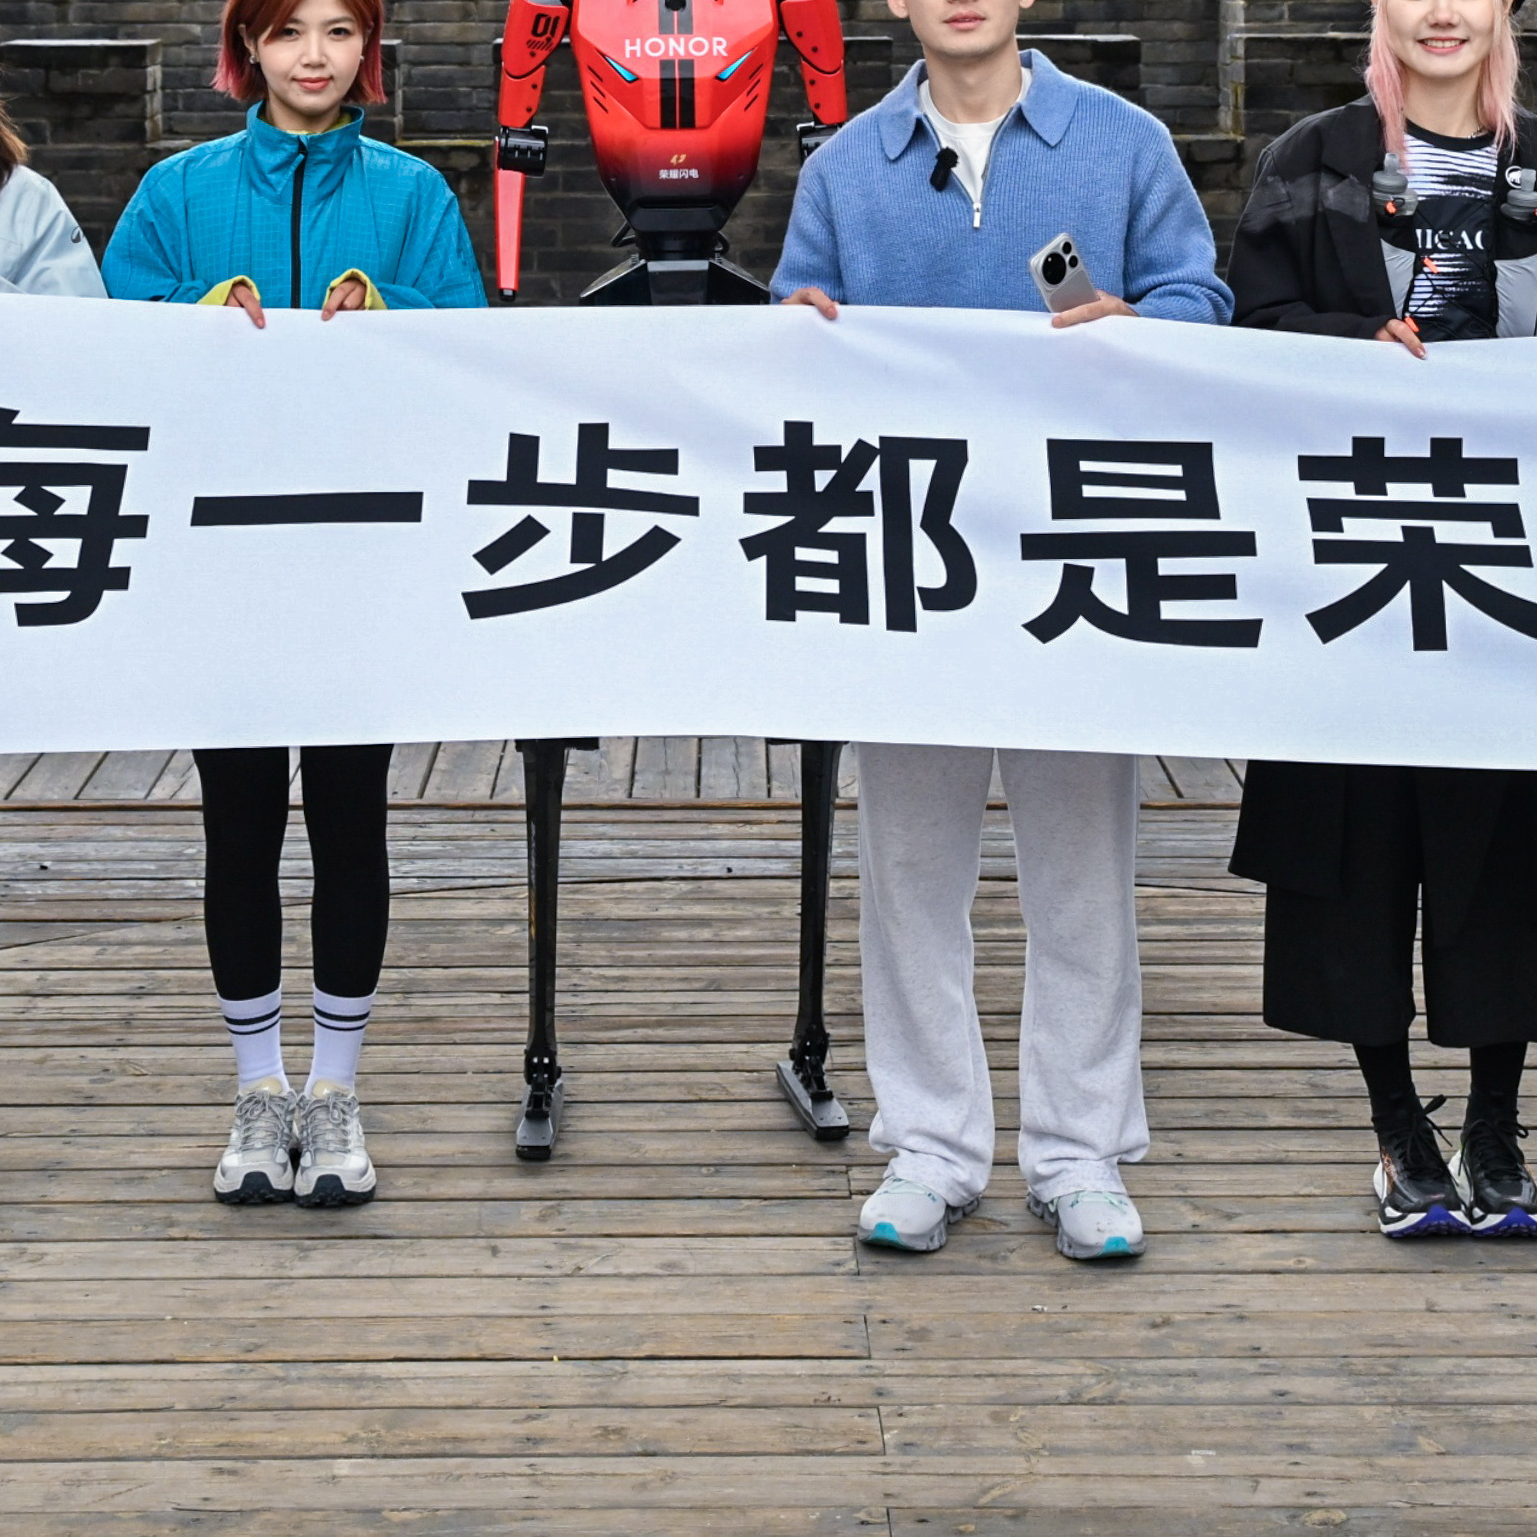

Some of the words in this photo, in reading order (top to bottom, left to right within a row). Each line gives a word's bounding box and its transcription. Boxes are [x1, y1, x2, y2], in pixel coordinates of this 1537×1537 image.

[624, 36, 729, 59] HONOR
[658, 168, 700, 180] 荣耀闪电
